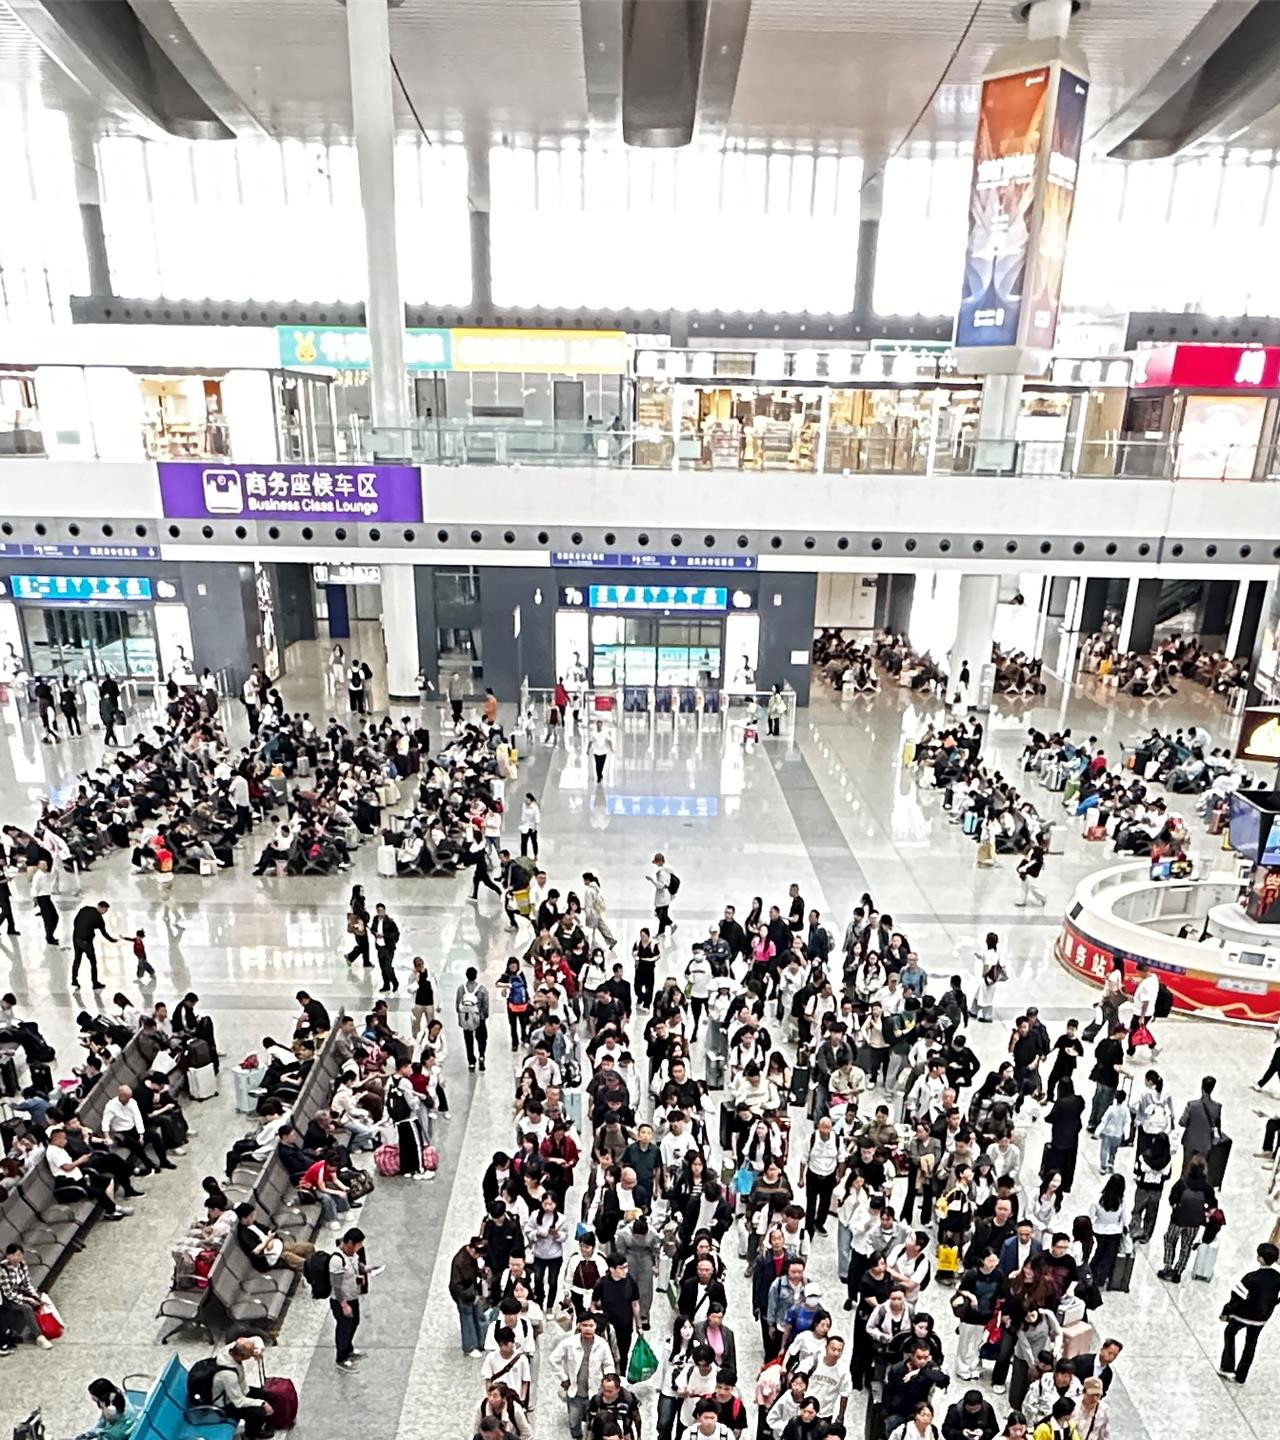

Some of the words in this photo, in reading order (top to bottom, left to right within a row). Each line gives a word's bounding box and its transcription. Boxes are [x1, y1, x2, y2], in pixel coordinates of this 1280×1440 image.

[244, 471, 378, 498] 商务座候车区
[247, 497, 301, 512] Business
[302, 498, 334, 513] Class
[336, 499, 379, 516] Lounge
